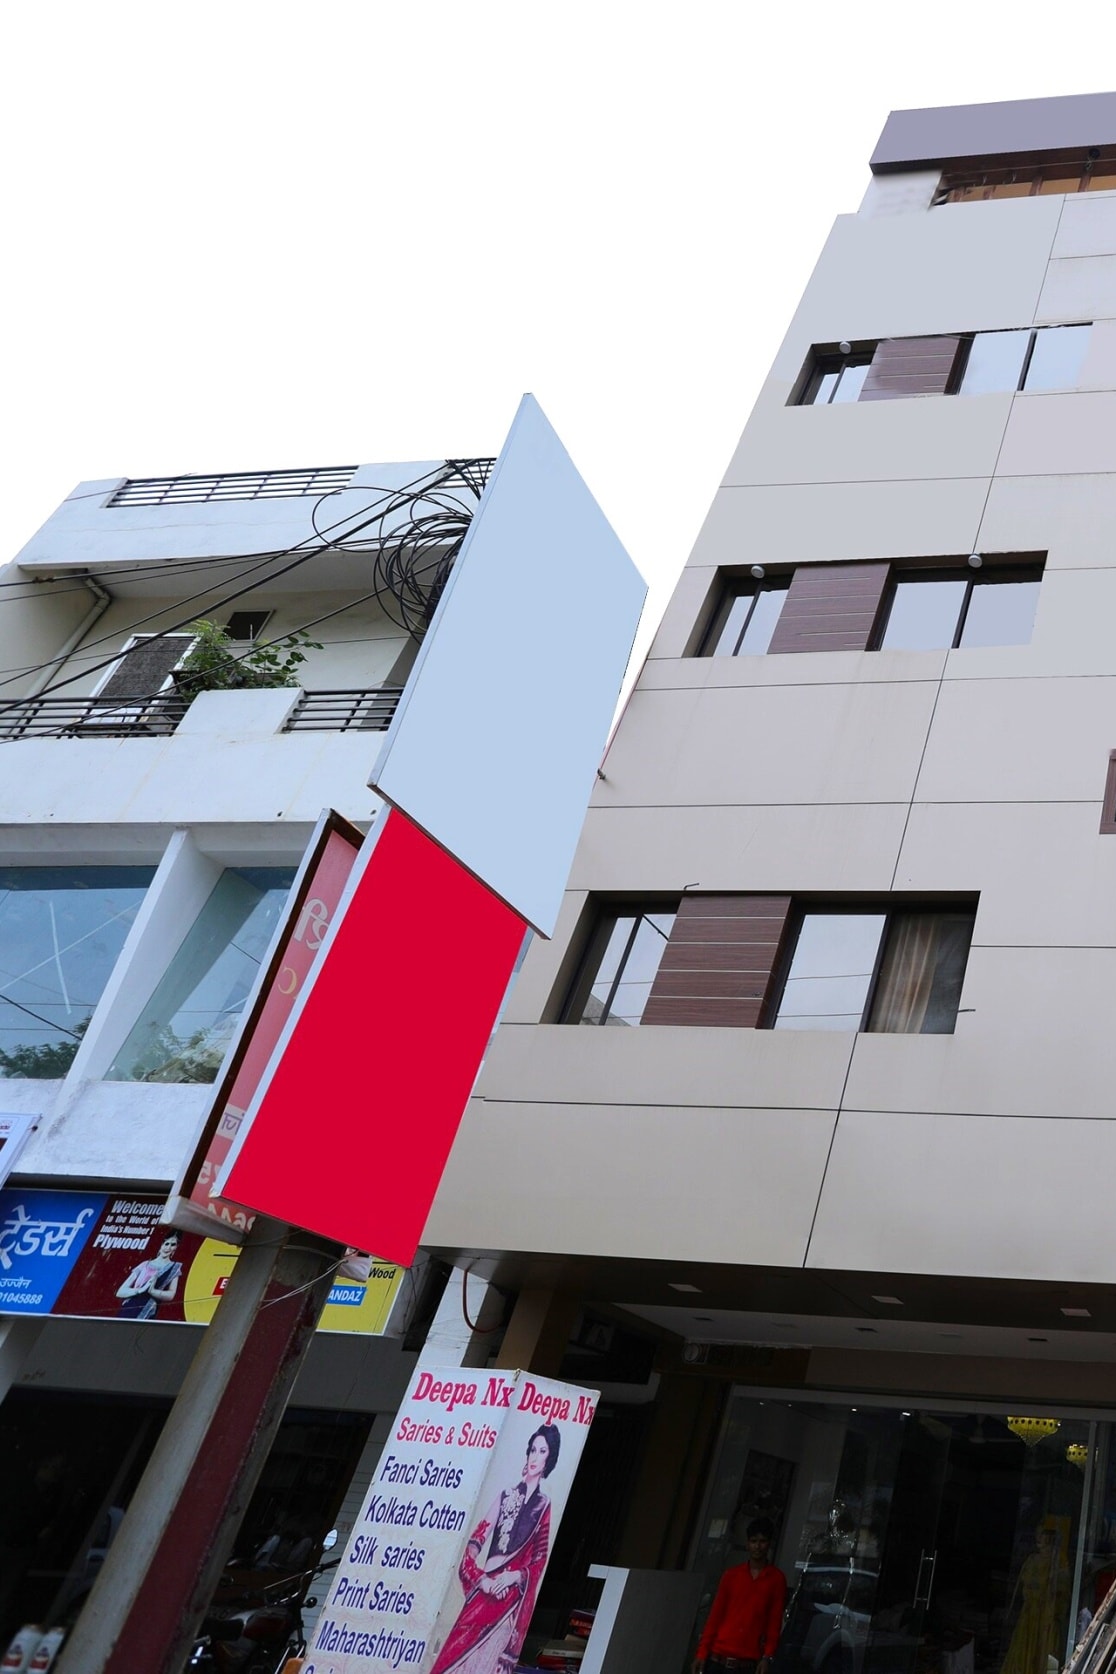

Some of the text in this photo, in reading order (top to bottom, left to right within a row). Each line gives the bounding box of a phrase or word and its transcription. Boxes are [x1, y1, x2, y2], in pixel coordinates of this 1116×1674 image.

[105, 1215, 159, 1225] to the World of
[111, 1200, 165, 1215] Welcome
[92, 1234, 150, 1251] Plywood
[100, 1225, 124, 1234] India's
[123, 1226, 150, 1235] Number
[327, 1289, 363, 1302] ANDAZ
[412, 1372, 515, 1411] Deepa Nx
[517, 1382, 570, 1426] Deepa
[397, 1417, 497, 1448] Saries & Suits
[380, 1456, 463, 1489] Fanci Saries
[365, 1495, 466, 1531] Kolkata Cotten
[350, 1535, 425, 1570] Silk saries
[332, 1577, 414, 1615] Print Saries
[315, 1620, 426, 1669] Maharashtriyan
